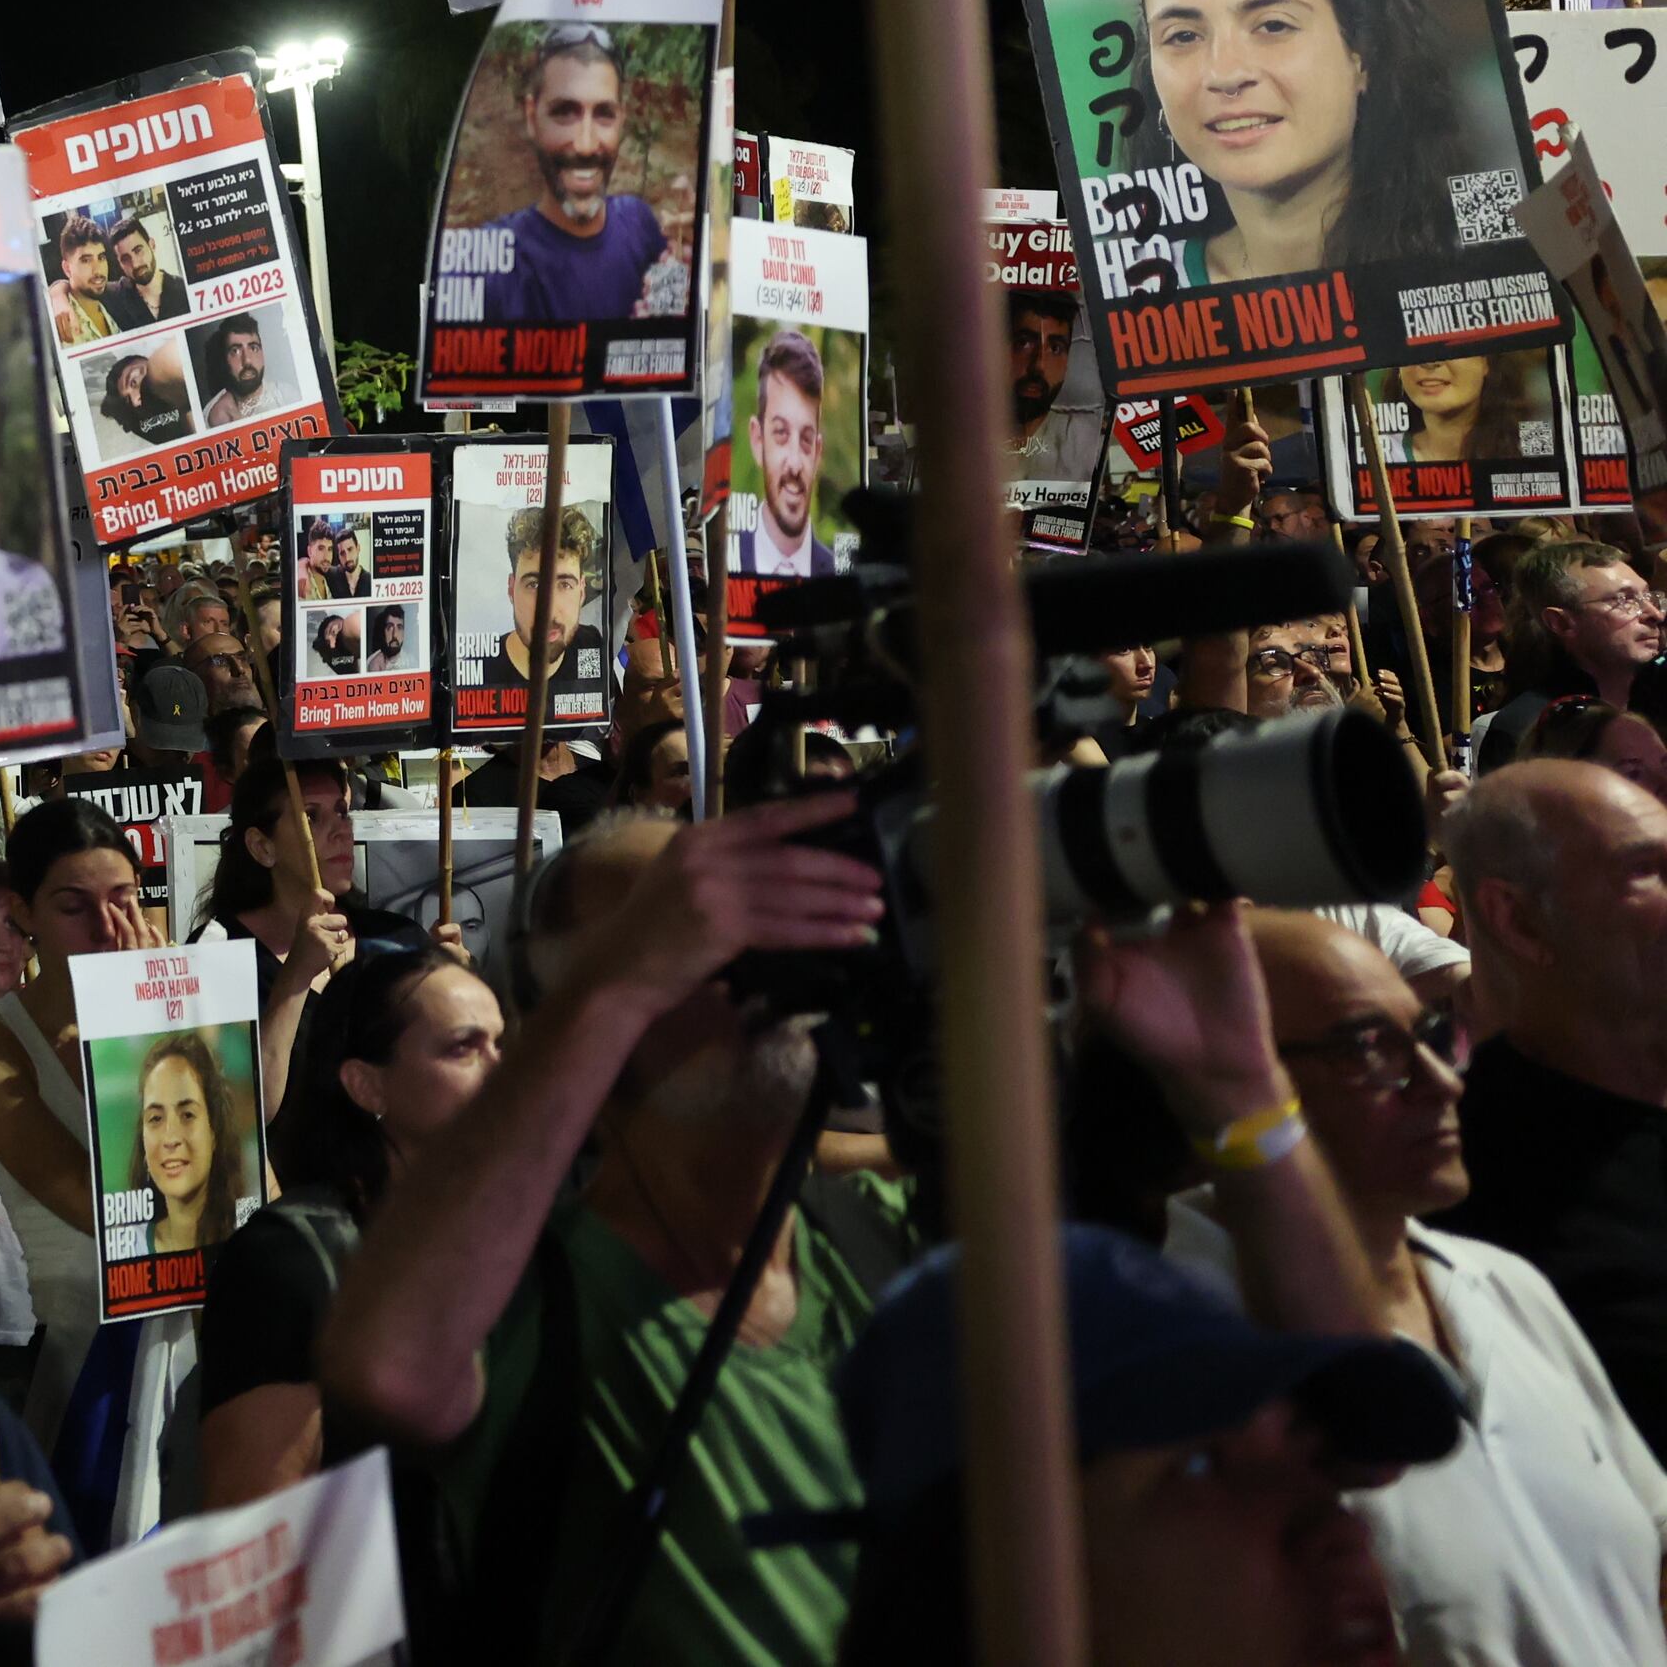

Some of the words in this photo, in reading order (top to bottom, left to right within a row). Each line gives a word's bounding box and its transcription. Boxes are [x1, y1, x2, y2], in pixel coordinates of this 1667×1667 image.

[64, 103, 214, 175] חטופים
[1082, 163, 1209, 234] BRING
[439, 227, 515, 274] BRING
[762, 259, 789, 283] DAVID
[790, 263, 816, 287] CUNIO
[195, 268, 284, 311] 7.10.2023
[436, 276, 485, 322] HIM
[1399, 288, 1463, 310] HOSTAGES
[1465, 281, 1489, 299] AND
[1490, 273, 1548, 295] MISSING
[1109, 289, 1230, 370] HOME
[1242, 271, 1359, 347] NOW!
[1402, 300, 1487, 340] FAMILIES
[1489, 292, 1555, 326] FORUM
[433, 328, 507, 376] HOME
[514, 323, 586, 373] NOW!
[1178, 422, 1204, 439] ALL
[175, 435, 245, 476] אותם
[97, 462, 166, 500] בבית
[320, 466, 404, 494] חטופים
[496, 472, 513, 487] GUY
[1417, 463, 1472, 496] NOW!
[1492, 484, 1530, 498] FAMILIES
[1531, 482, 1562, 497] FORUM
[102, 493, 158, 534] Bring
[160, 478, 217, 514] Them
[526, 488, 542, 504] (22)
[1034, 487, 1088, 503] Hamas
[374, 538, 383, 547] 22
[375, 581, 423, 598] 7.10.2023
[457, 632, 500, 658] BRING
[456, 659, 484, 686] HIM
[301, 685, 339, 701] בבית
[346, 682, 383, 698] אותם
[390, 679, 425, 695] רוצים
[300, 705, 331, 725] Bring
[335, 702, 365, 719] Them
[367, 700, 399, 717] Home
[401, 698, 424, 714] Now
[457, 689, 498, 715] HOME
[135, 982, 166, 1002] INBAR
[167, 977, 200, 997] HAYMAN
[166, 1000, 184, 1021] (27)
[104, 1188, 154, 1227] BRING
[105, 1226, 137, 1262] HER
[107, 1255, 153, 1300] HOME
[156, 1249, 206, 1292] NOW!
